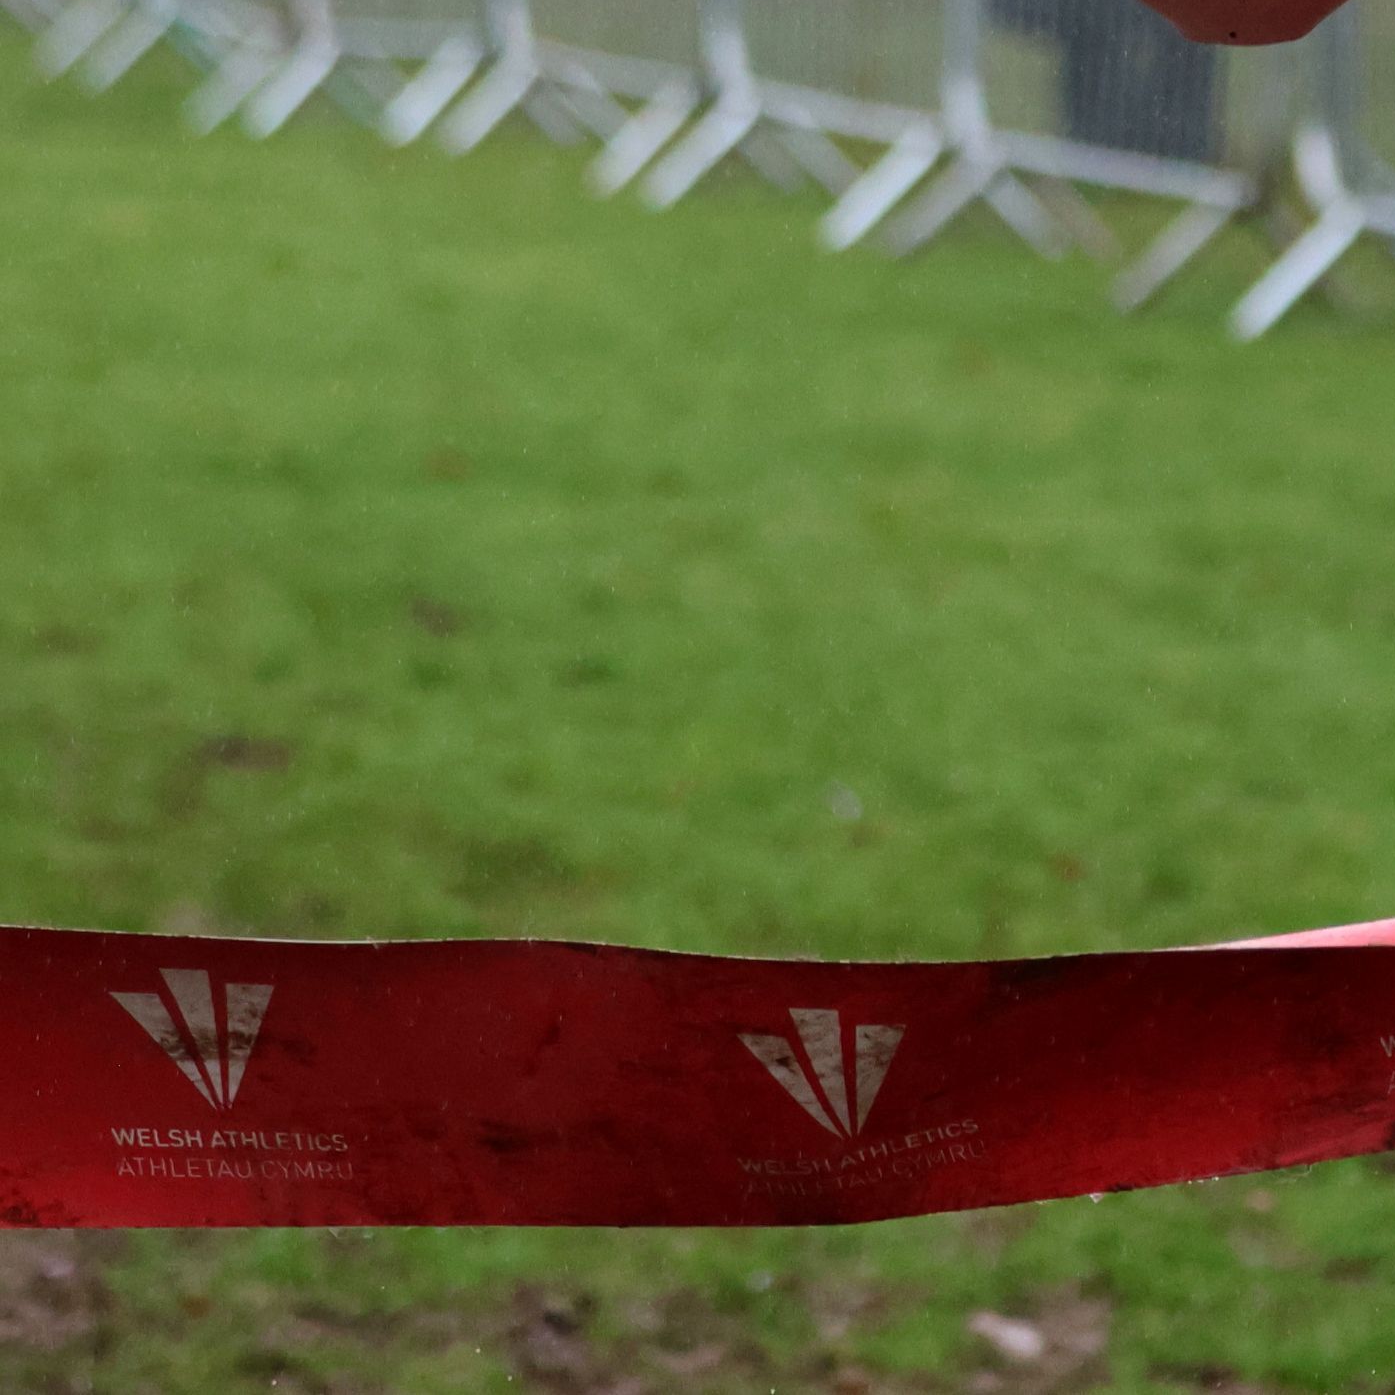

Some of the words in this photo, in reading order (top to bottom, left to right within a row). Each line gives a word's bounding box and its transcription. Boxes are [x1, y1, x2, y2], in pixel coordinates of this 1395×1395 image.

[111, 1128, 203, 1148] WELSH
[211, 1130, 349, 1151] ATHLETICS
[737, 1156, 831, 1174] WELSH
[840, 1119, 979, 1170] ATHLETICS
[117, 1157, 252, 1179] ATHLETAU
[260, 1160, 353, 1180] CYMRU
